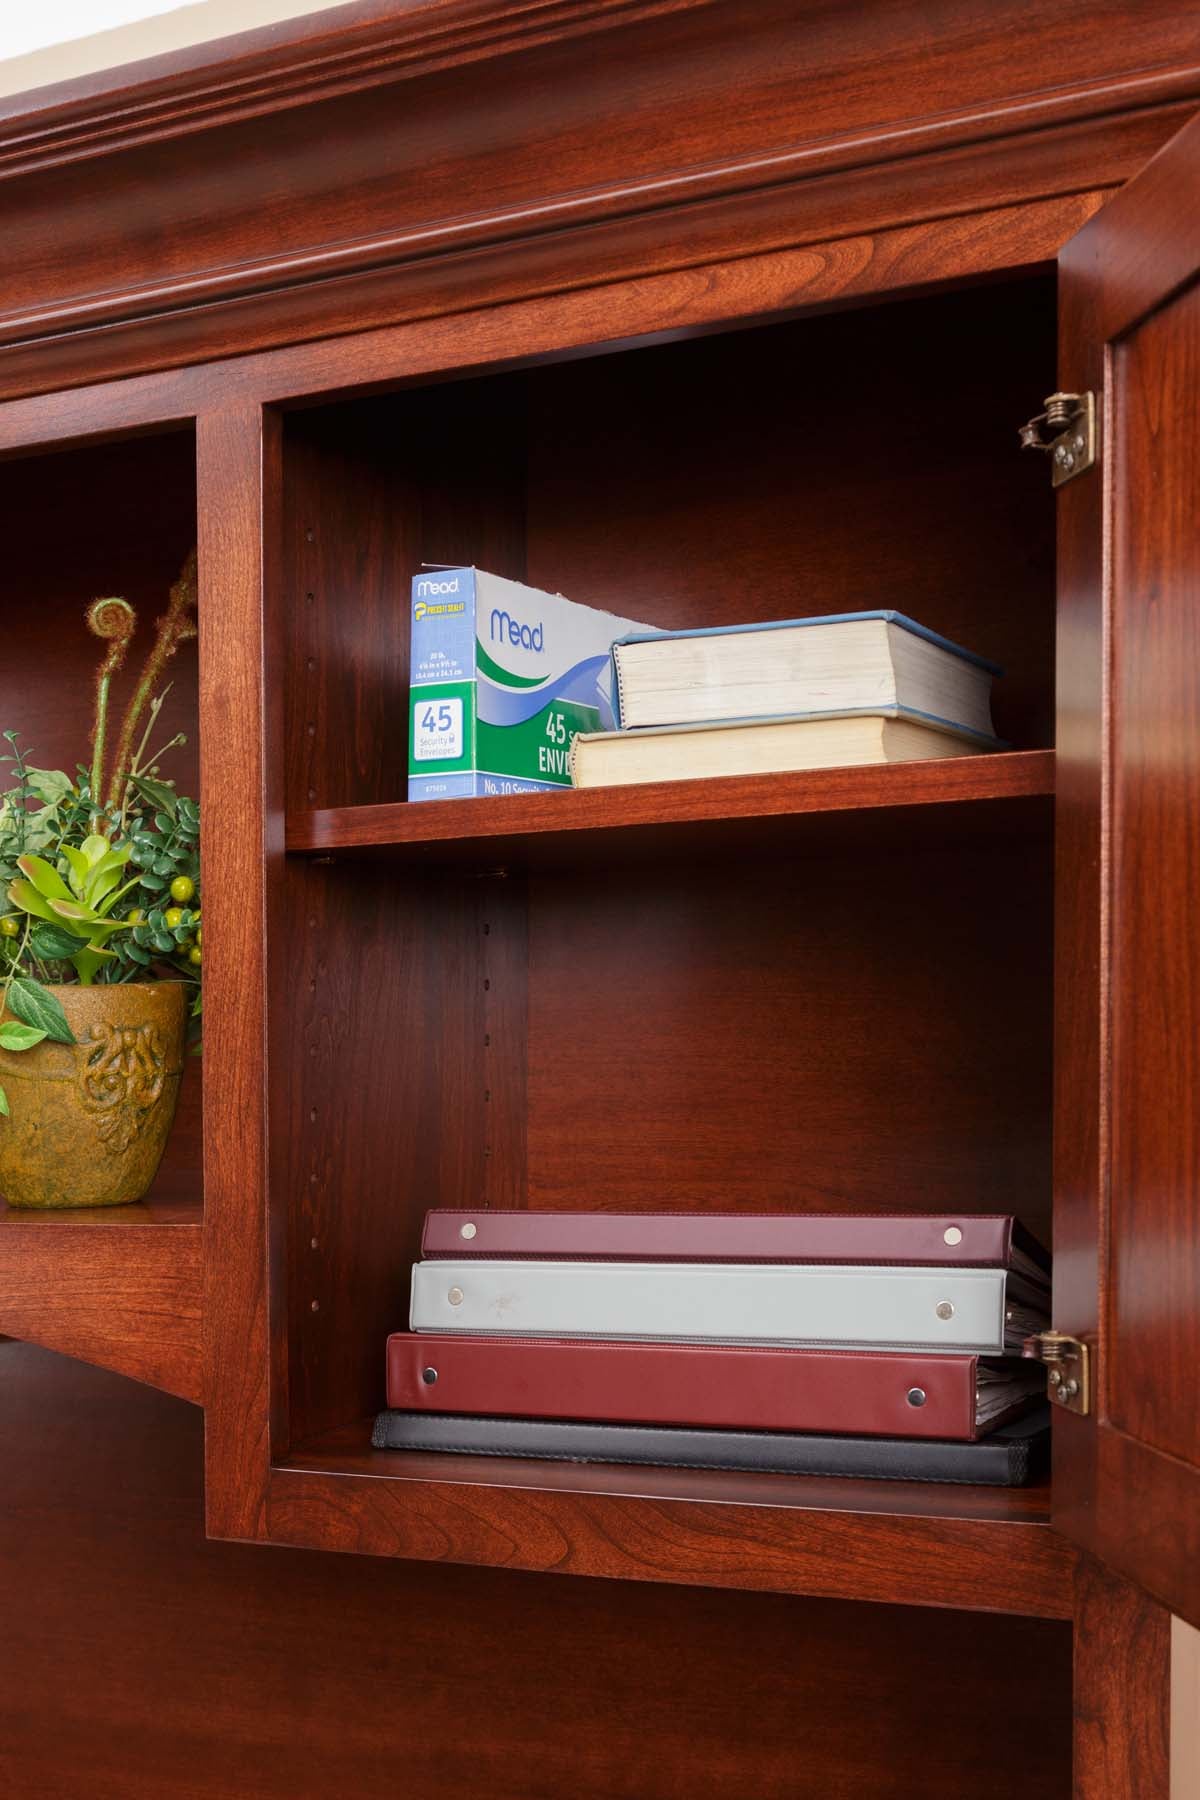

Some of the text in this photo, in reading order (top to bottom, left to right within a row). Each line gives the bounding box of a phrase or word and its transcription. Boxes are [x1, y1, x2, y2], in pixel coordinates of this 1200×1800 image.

[421, 705, 452, 732] 45
[546, 711, 566, 744] 45
[420, 736, 448, 747] Security
[420, 748, 456, 757] Envelopes
[484, 779, 499, 794] No.
